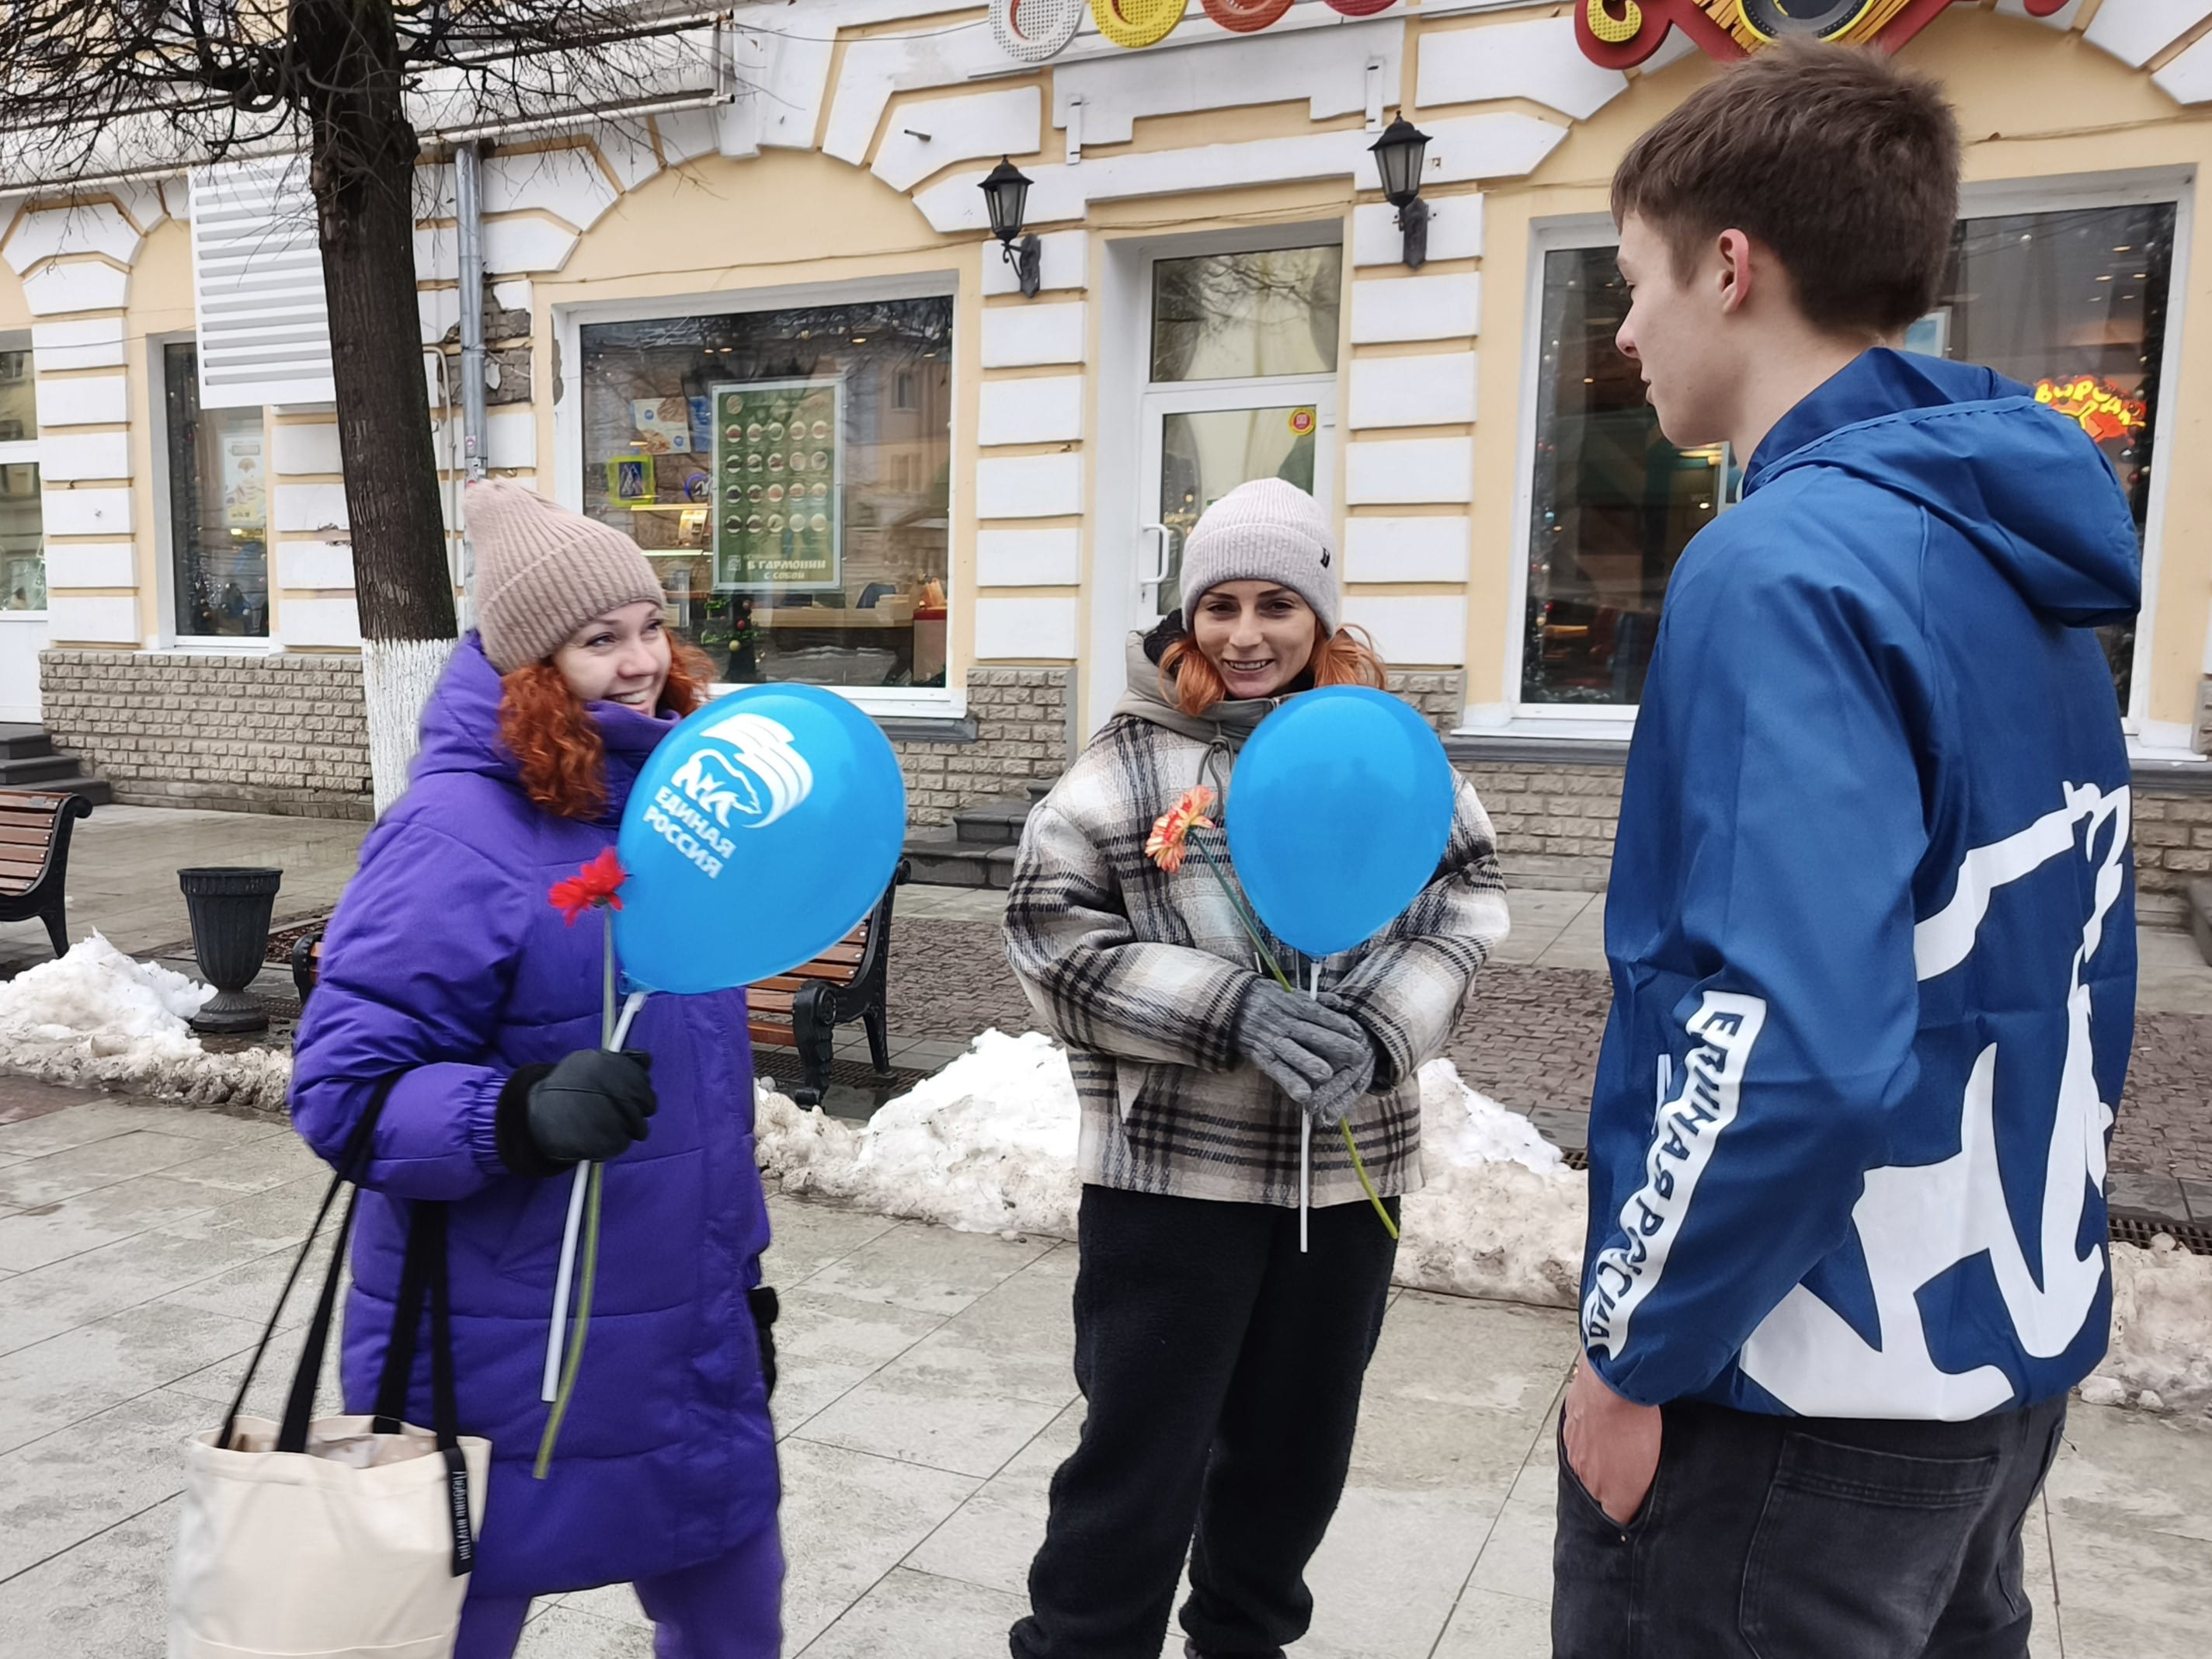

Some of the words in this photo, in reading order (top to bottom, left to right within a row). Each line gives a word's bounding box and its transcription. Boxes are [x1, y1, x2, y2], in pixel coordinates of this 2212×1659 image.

[759, 560, 826, 570] ГАРМОНИИ
[643, 804, 724, 878] РОССИЯ
[655, 784, 737, 860] ЕДИНАЯ
